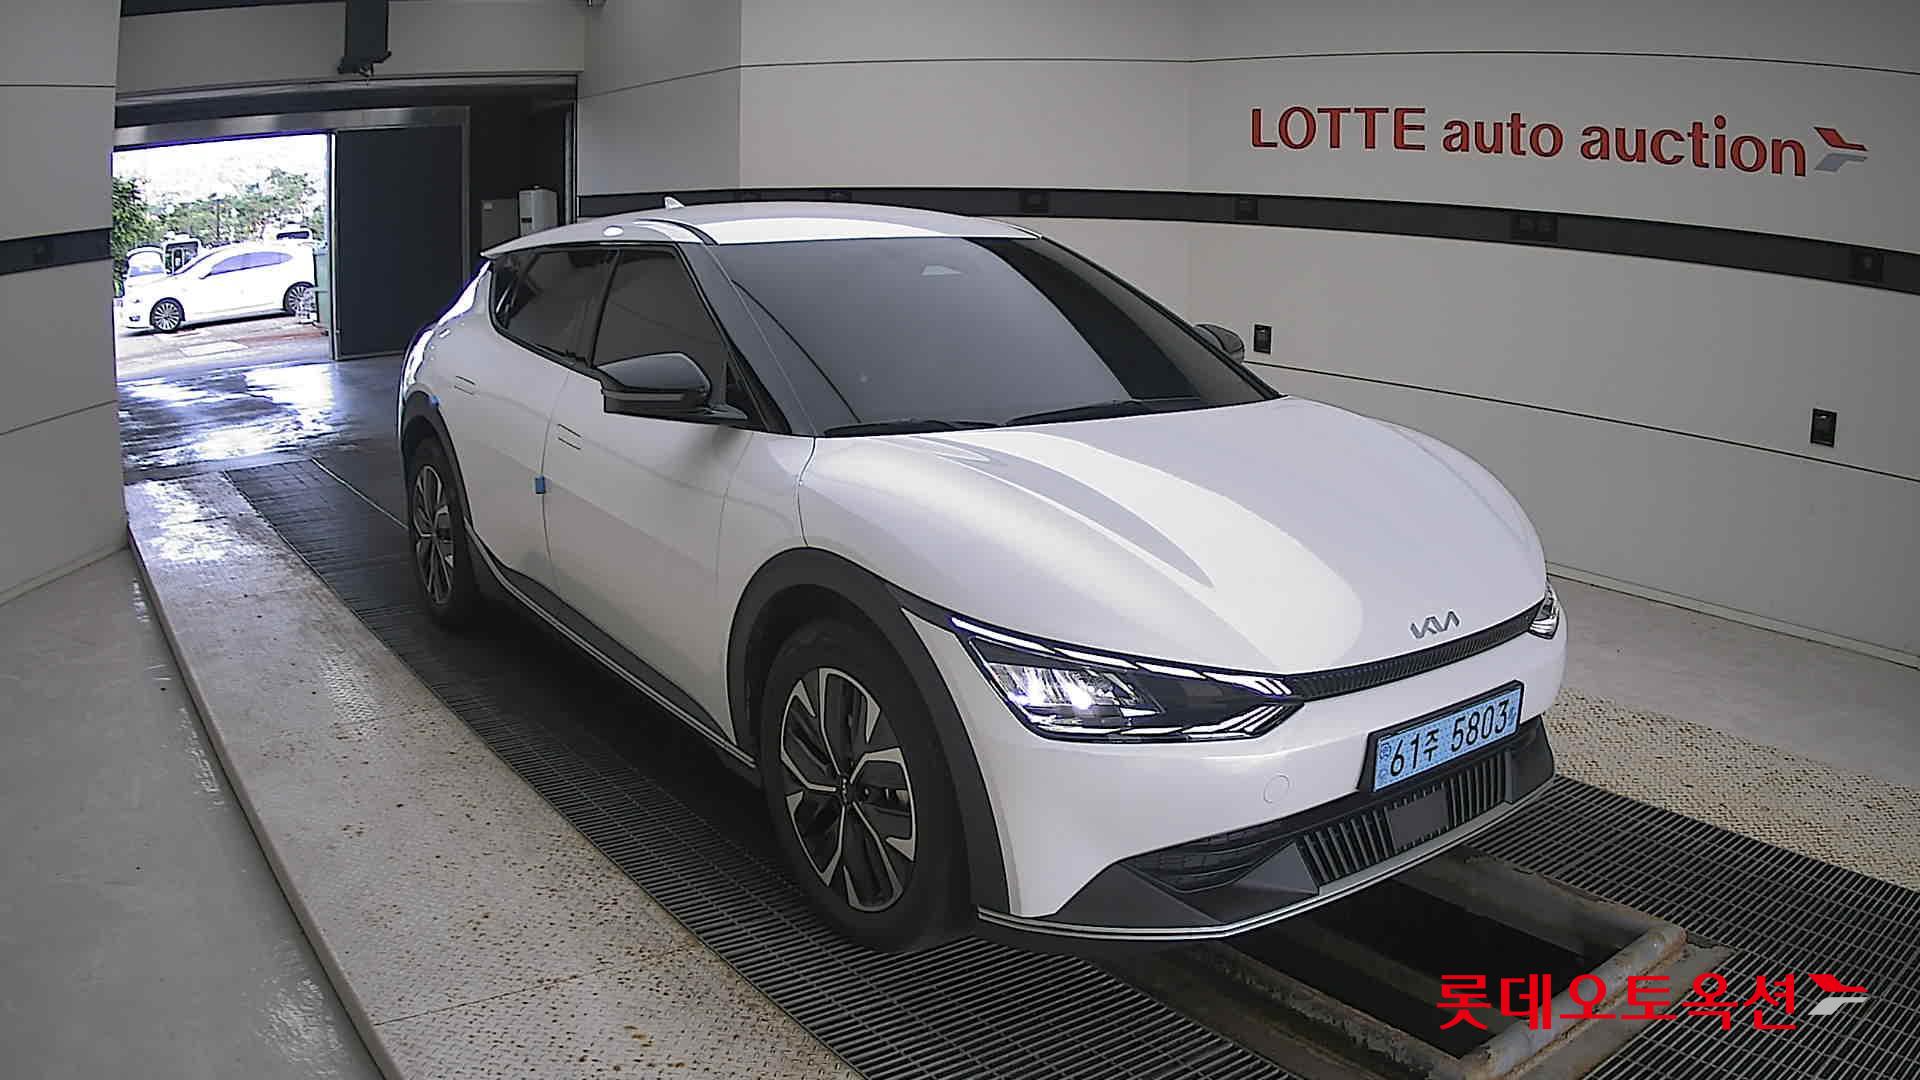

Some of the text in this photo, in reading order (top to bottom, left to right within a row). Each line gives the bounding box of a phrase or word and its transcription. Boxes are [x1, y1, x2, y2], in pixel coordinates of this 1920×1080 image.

[1250, 106, 1807, 177] LOTTE auto auction
[1390, 699, 1510, 777] 61주 5803
